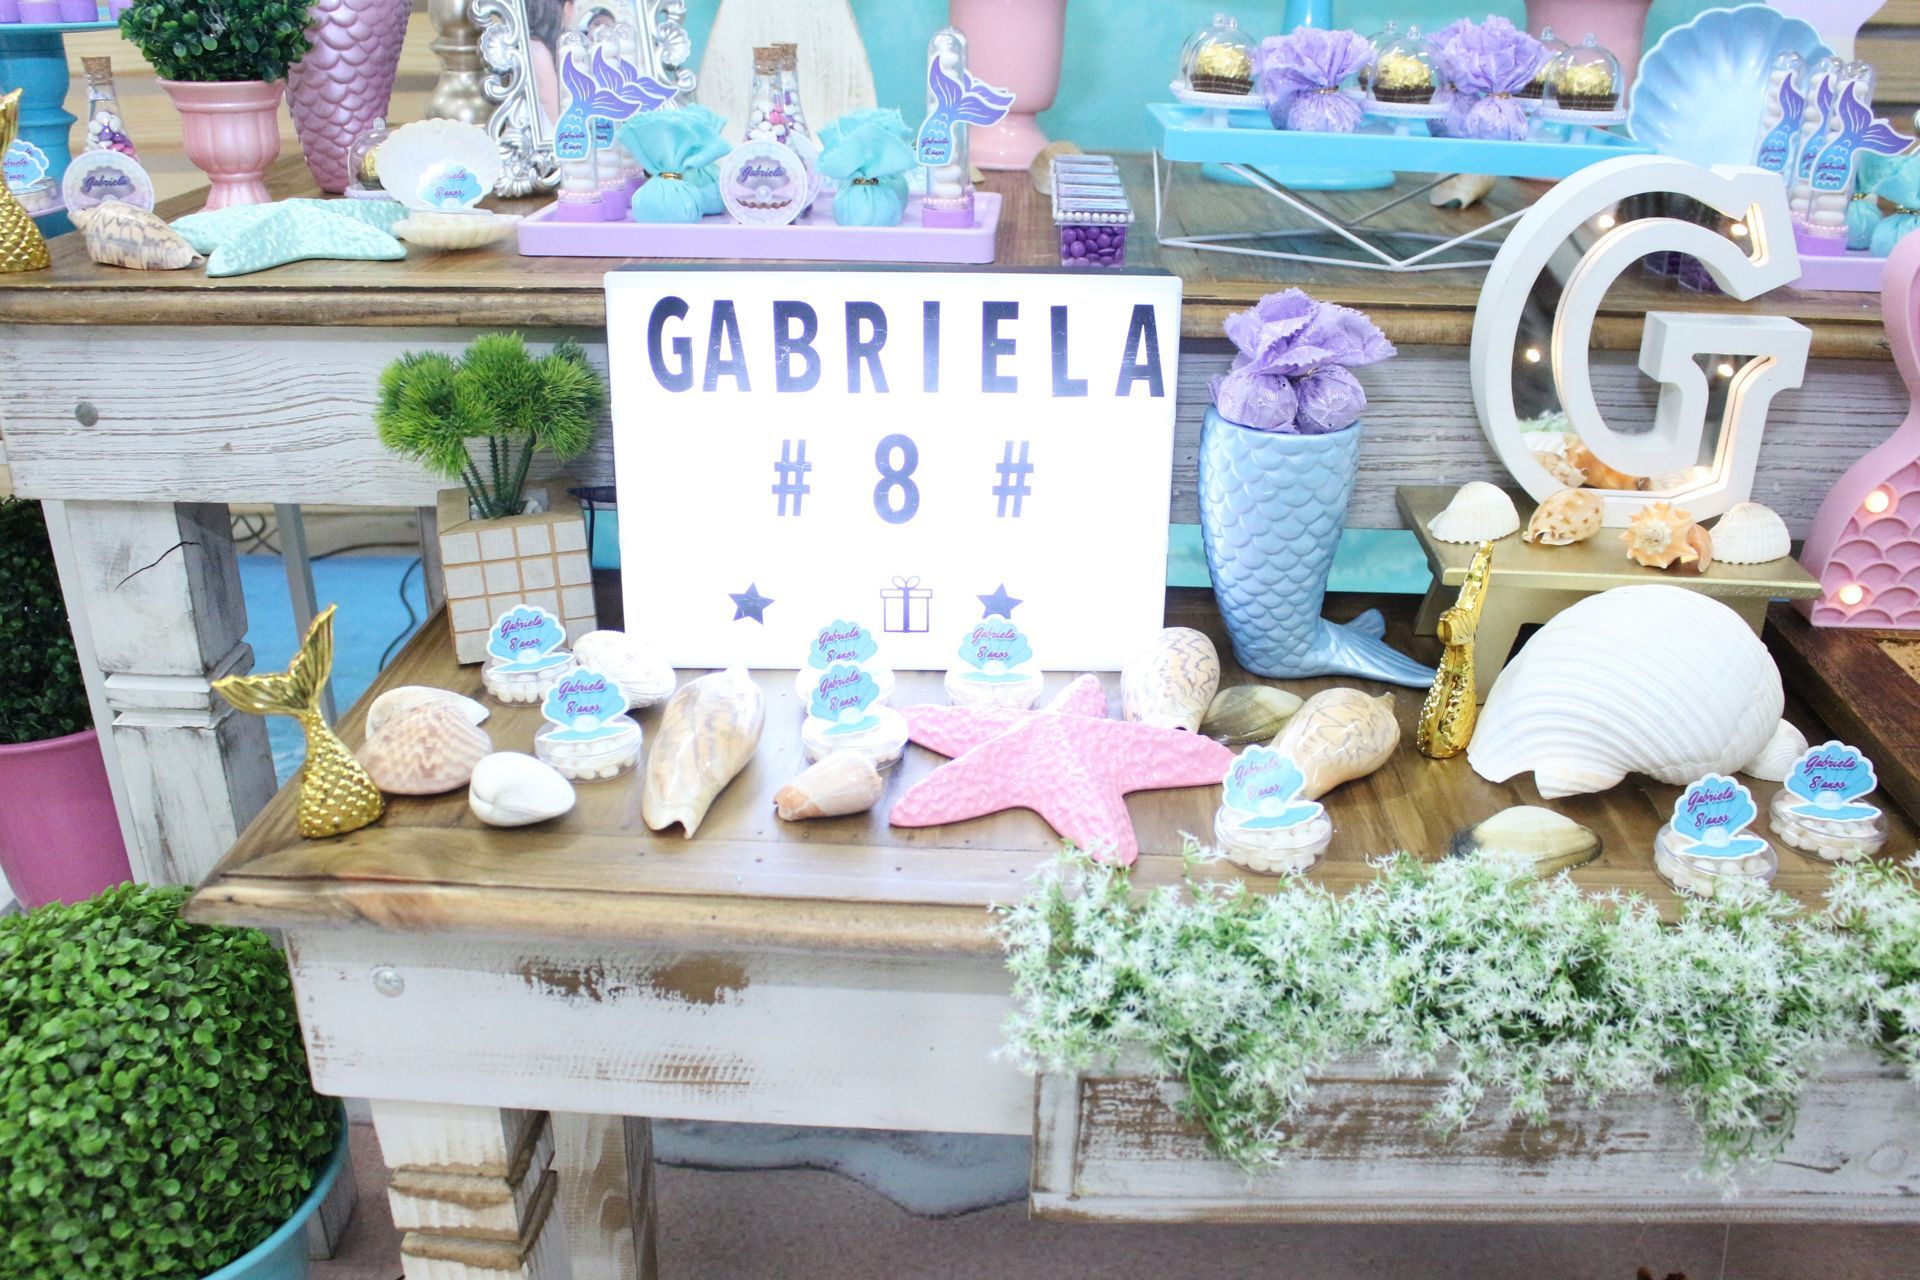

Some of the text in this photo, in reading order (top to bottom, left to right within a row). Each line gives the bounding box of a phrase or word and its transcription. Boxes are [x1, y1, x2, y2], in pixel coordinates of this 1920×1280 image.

[558, 132, 585, 143] Gabriela
[921, 137, 949, 148] Gabriela
[741, 164, 786, 183] Gabriela
[84, 174, 130, 193] Gabriela
[646, 295, 1166, 398] GABRIELA
[873, 433, 920, 525] 8
[501, 614, 545, 639] Gabriela
[971, 626, 1017, 646] Gabriela
[509, 637, 541, 650] 8 anos
[819, 626, 860, 650] Gabriela
[827, 649, 856, 663] 8 anos
[977, 645, 1009, 660] 8 anos
[558, 679, 607, 700] Gabriela
[820, 670, 860, 700] Gabriela
[566, 700, 601, 715] 8 anos
[829, 695, 859, 711] 8 anos
[1234, 756, 1281, 788] Gabriela
[1804, 754, 1857, 774] Gabriela
[1257, 783, 1281, 798] anos
[1809, 775, 1847, 791] 8 anos
[1687, 786, 1735, 812] Gabriela
[1694, 812, 1729, 828] 8 anos
